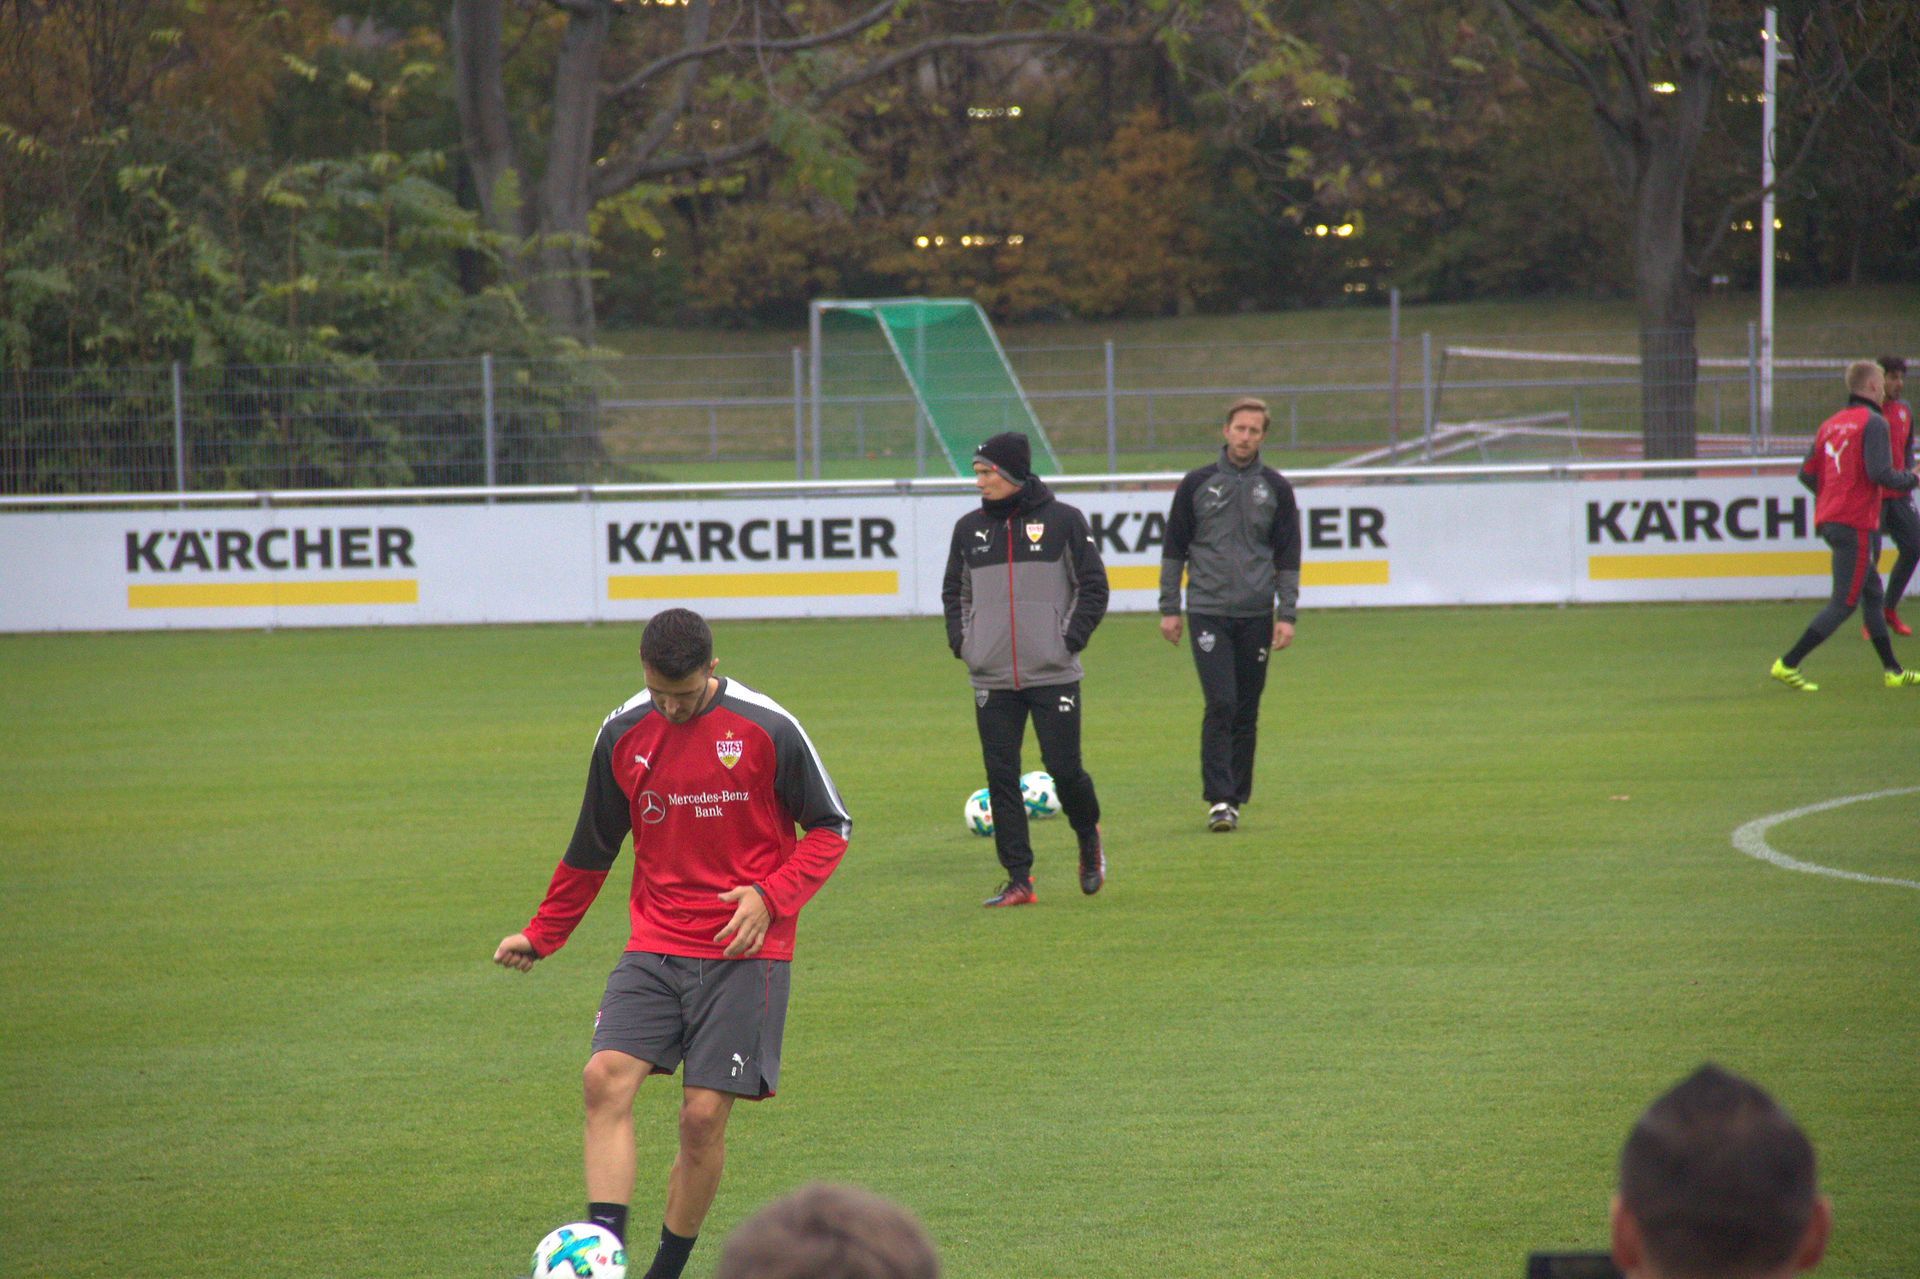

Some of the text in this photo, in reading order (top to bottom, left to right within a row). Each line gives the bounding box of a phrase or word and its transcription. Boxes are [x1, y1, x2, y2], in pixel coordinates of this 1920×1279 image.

[609, 518, 897, 563] KÄRCHER
[1091, 507, 1387, 553] KÄER
[1588, 495, 1824, 543] KÄRCH
[126, 527, 415, 572] KÄRCHER
[668, 790, 749, 805] Mercedes-Benz
[695, 805, 723, 818] Bank
